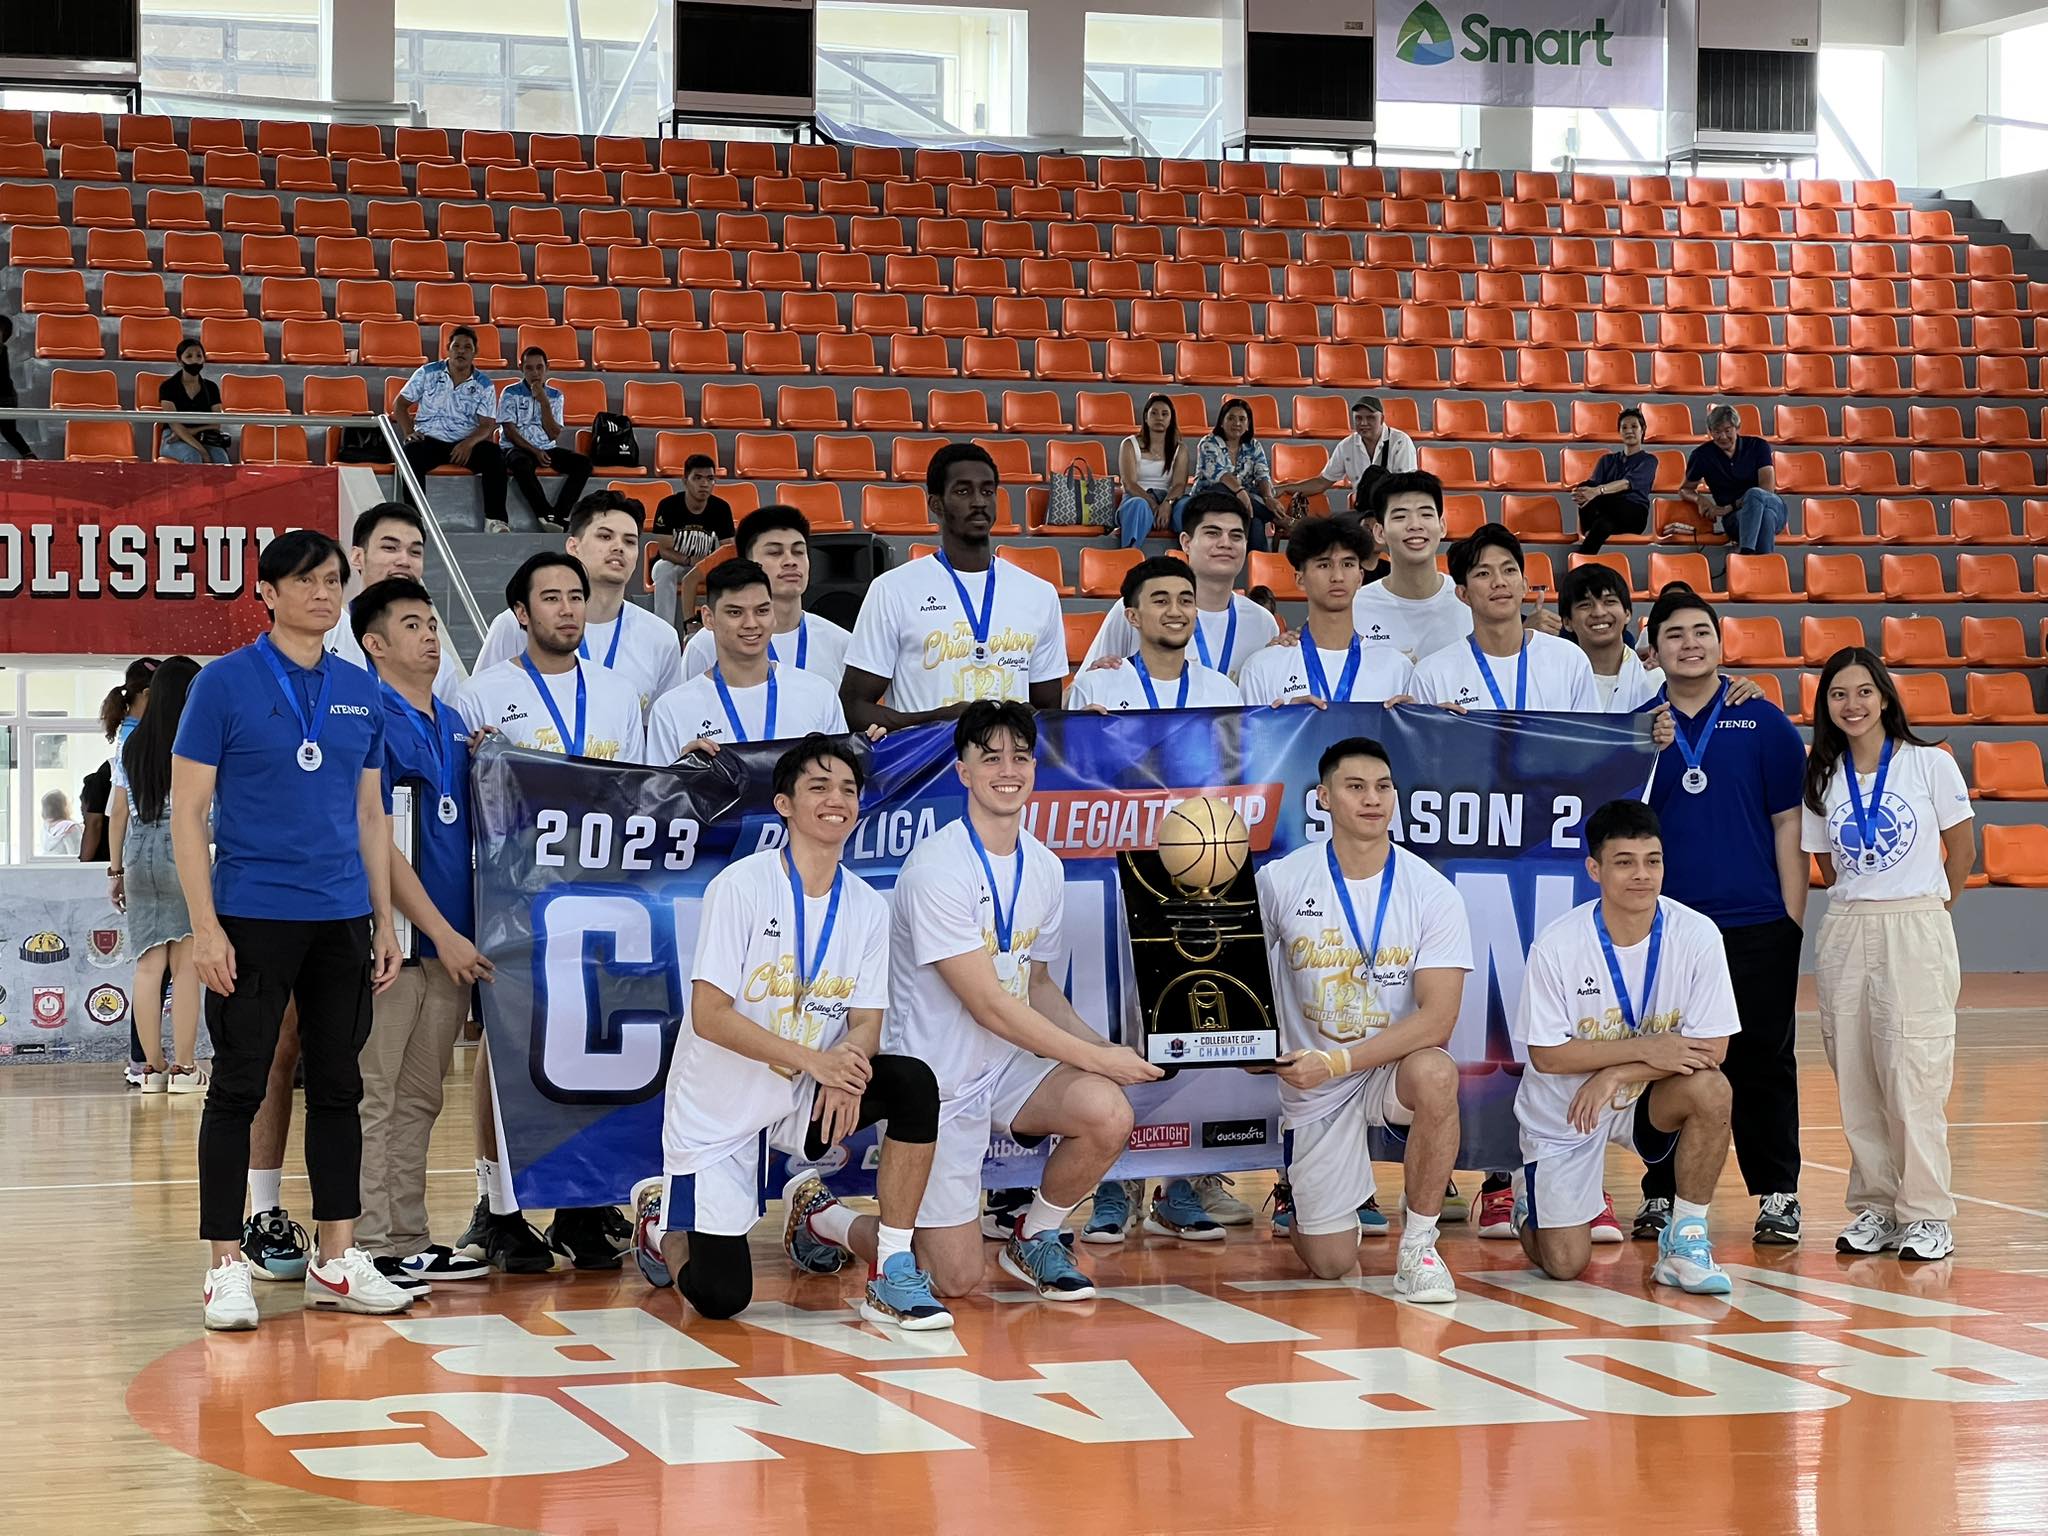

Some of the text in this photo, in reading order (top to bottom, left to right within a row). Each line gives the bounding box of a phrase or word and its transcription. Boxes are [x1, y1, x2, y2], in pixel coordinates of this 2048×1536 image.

[1460, 13, 1614, 67] Smart
[0, 523, 303, 593] OLISEU
[920, 604, 946, 612] Antbox
[1283, 683, 1307, 694] Antbox
[1454, 695, 1480, 706] Antbox
[329, 704, 369, 716] ATENEO
[501, 711, 528, 724] Antbox
[1714, 720, 1757, 729] TENEO
[696, 728, 722, 740] Antbox
[1831, 795, 1906, 827] ATEO
[536, 809, 699, 870] 2023
[1551, 795, 1583, 849] 2
[1295, 908, 1323, 918] Antbox
[1200, 1035, 1255, 1045] COLLEGIATE CUP
[1199, 1046, 1256, 1058] CHAMPION
[1130, 1125, 1189, 1145] SLICKTIGHT
[1216, 1128, 1264, 1141] ducksports
